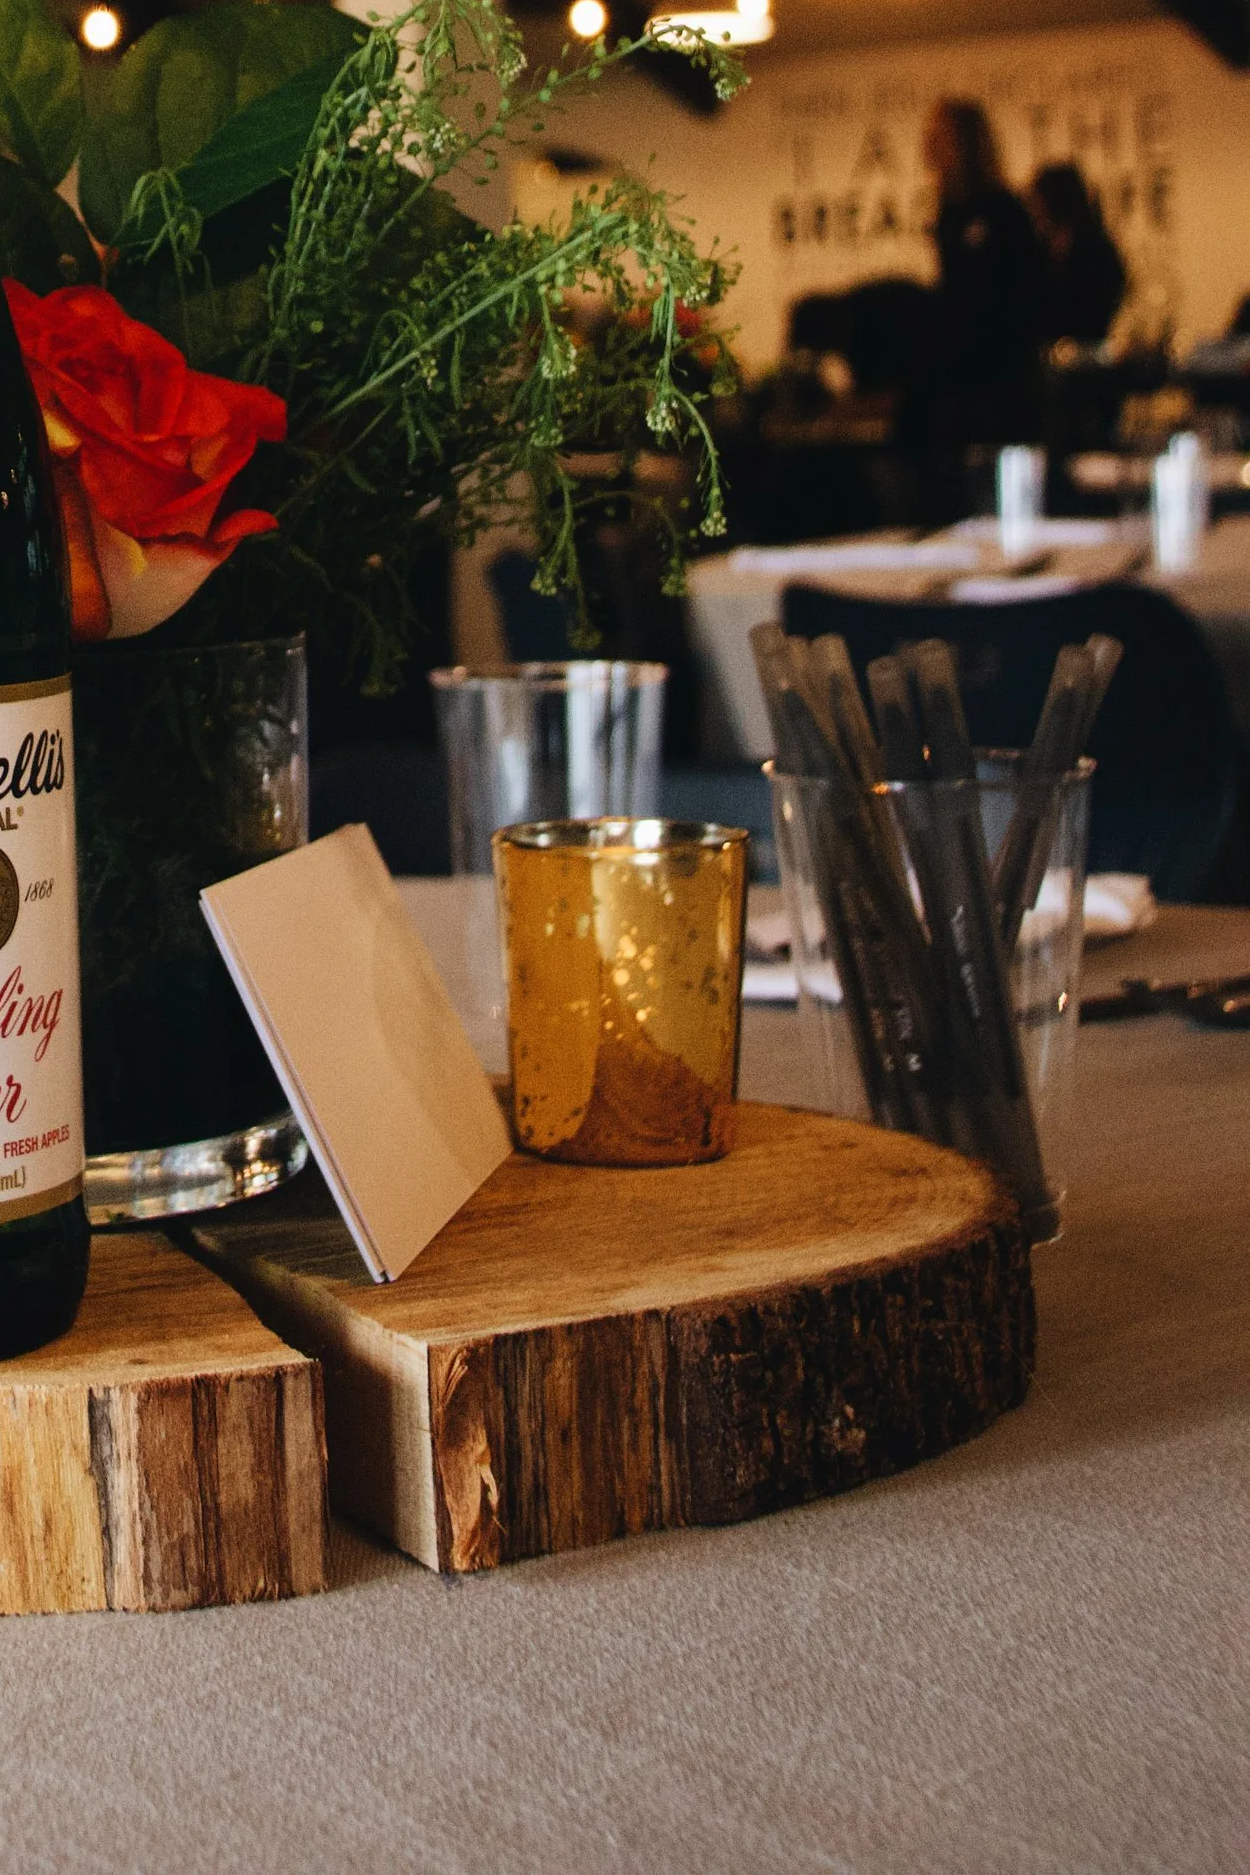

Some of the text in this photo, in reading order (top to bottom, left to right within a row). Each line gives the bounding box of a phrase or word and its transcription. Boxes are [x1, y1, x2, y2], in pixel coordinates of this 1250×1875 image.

[23, 876, 55, 905] 1868
[3, 1136, 39, 1163] FRESH
[40, 1124, 71, 1152] APPLES
